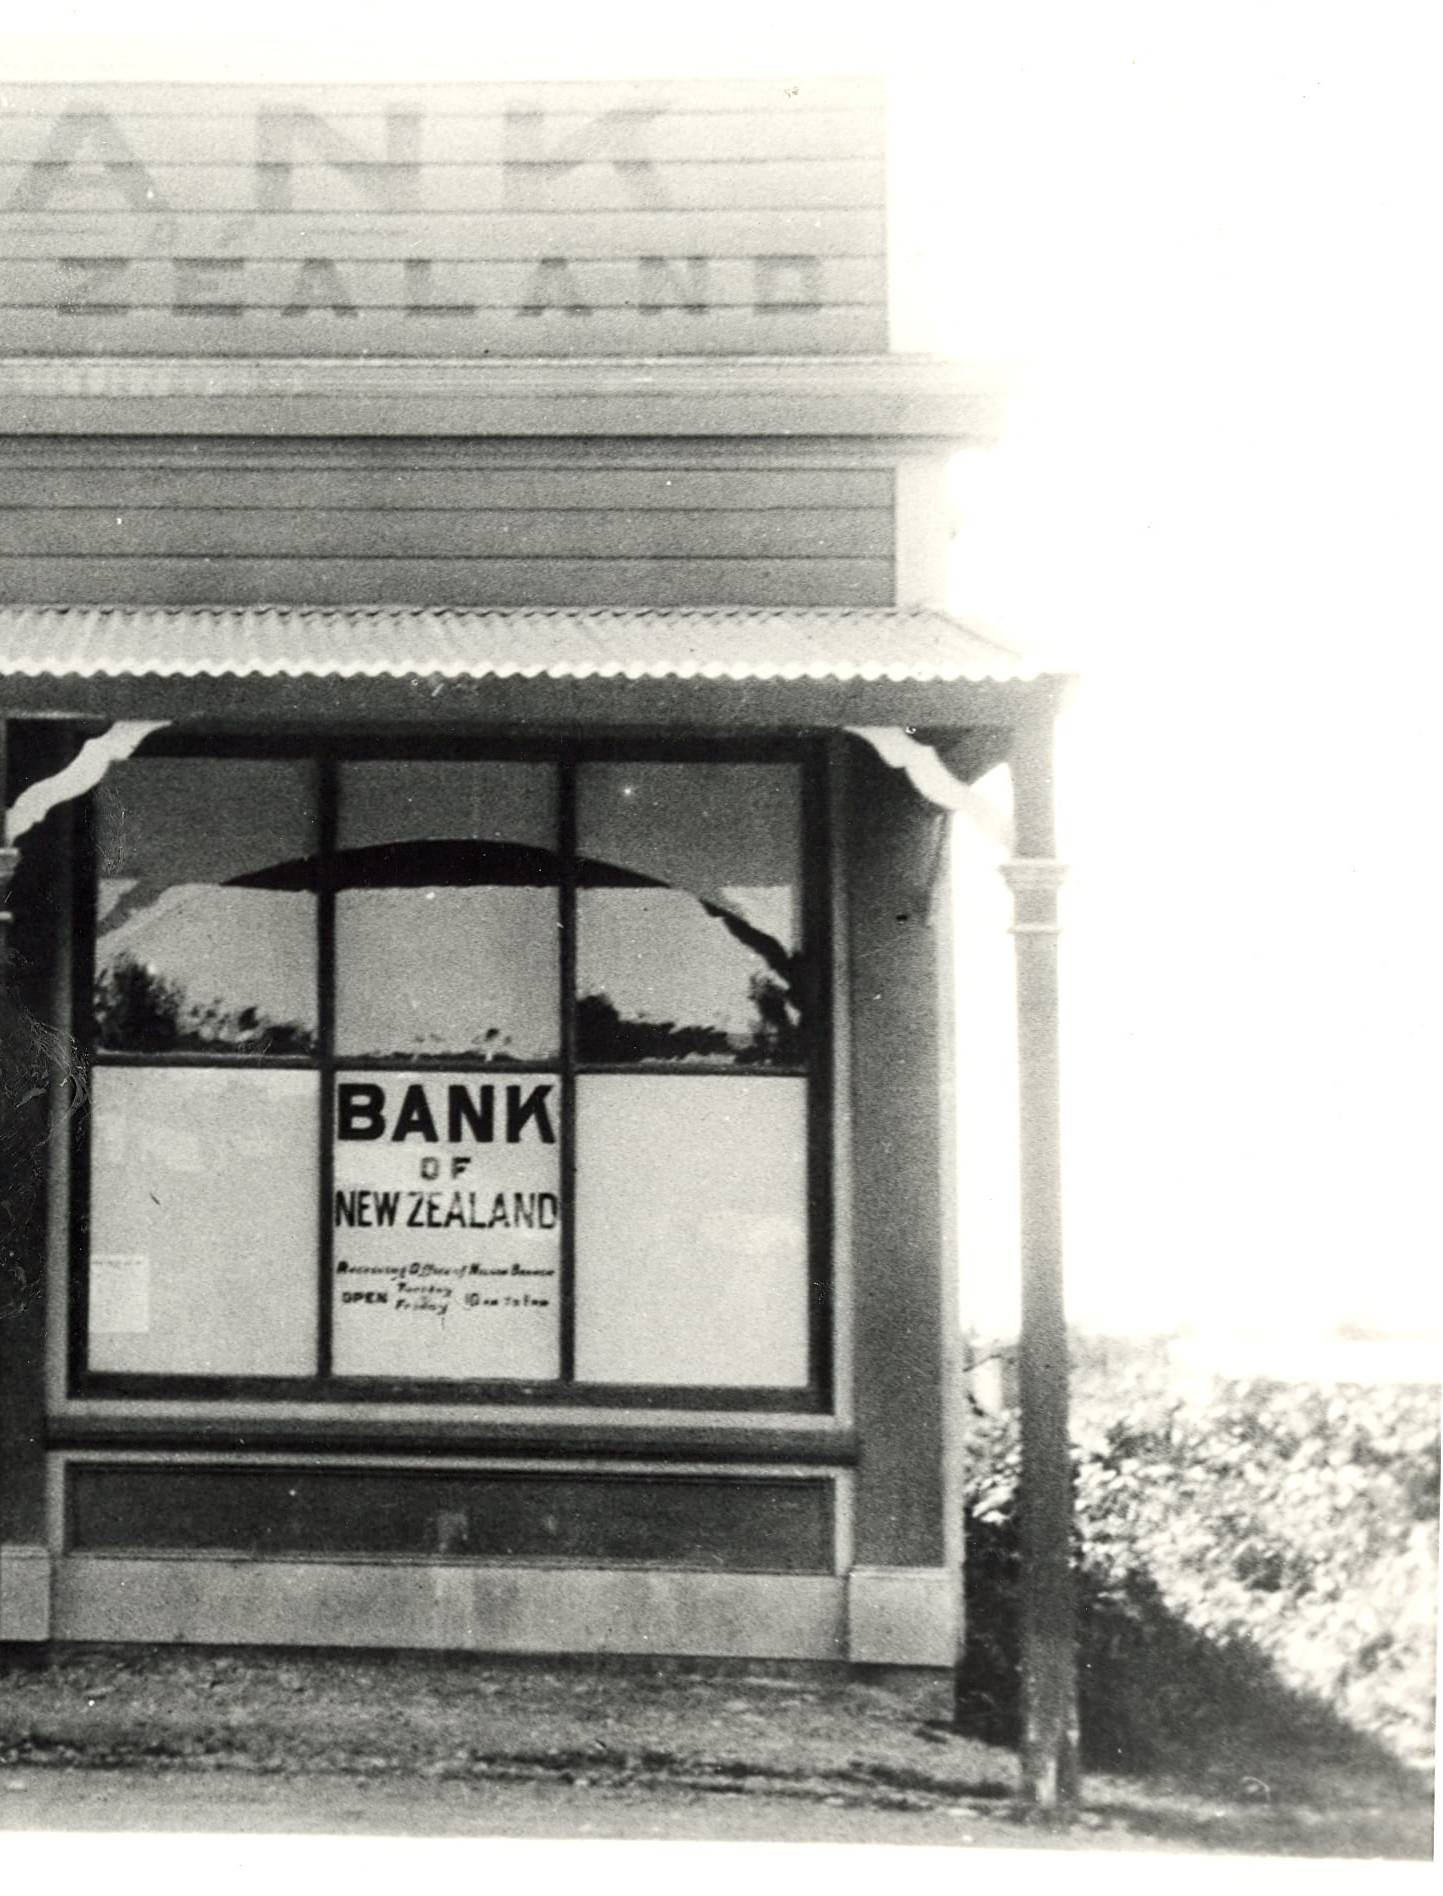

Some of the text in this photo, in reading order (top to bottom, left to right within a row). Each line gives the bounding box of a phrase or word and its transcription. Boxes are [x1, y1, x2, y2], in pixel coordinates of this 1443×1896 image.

[55, 255, 823, 317] ZEALAND
[337, 1083, 556, 1144] BANK
[420, 1156, 471, 1181] OF
[335, 1190, 558, 1229] NEW ZEALAND
[341, 1291, 388, 1304] OPEN
[395, 1299, 449, 1315] Friday
